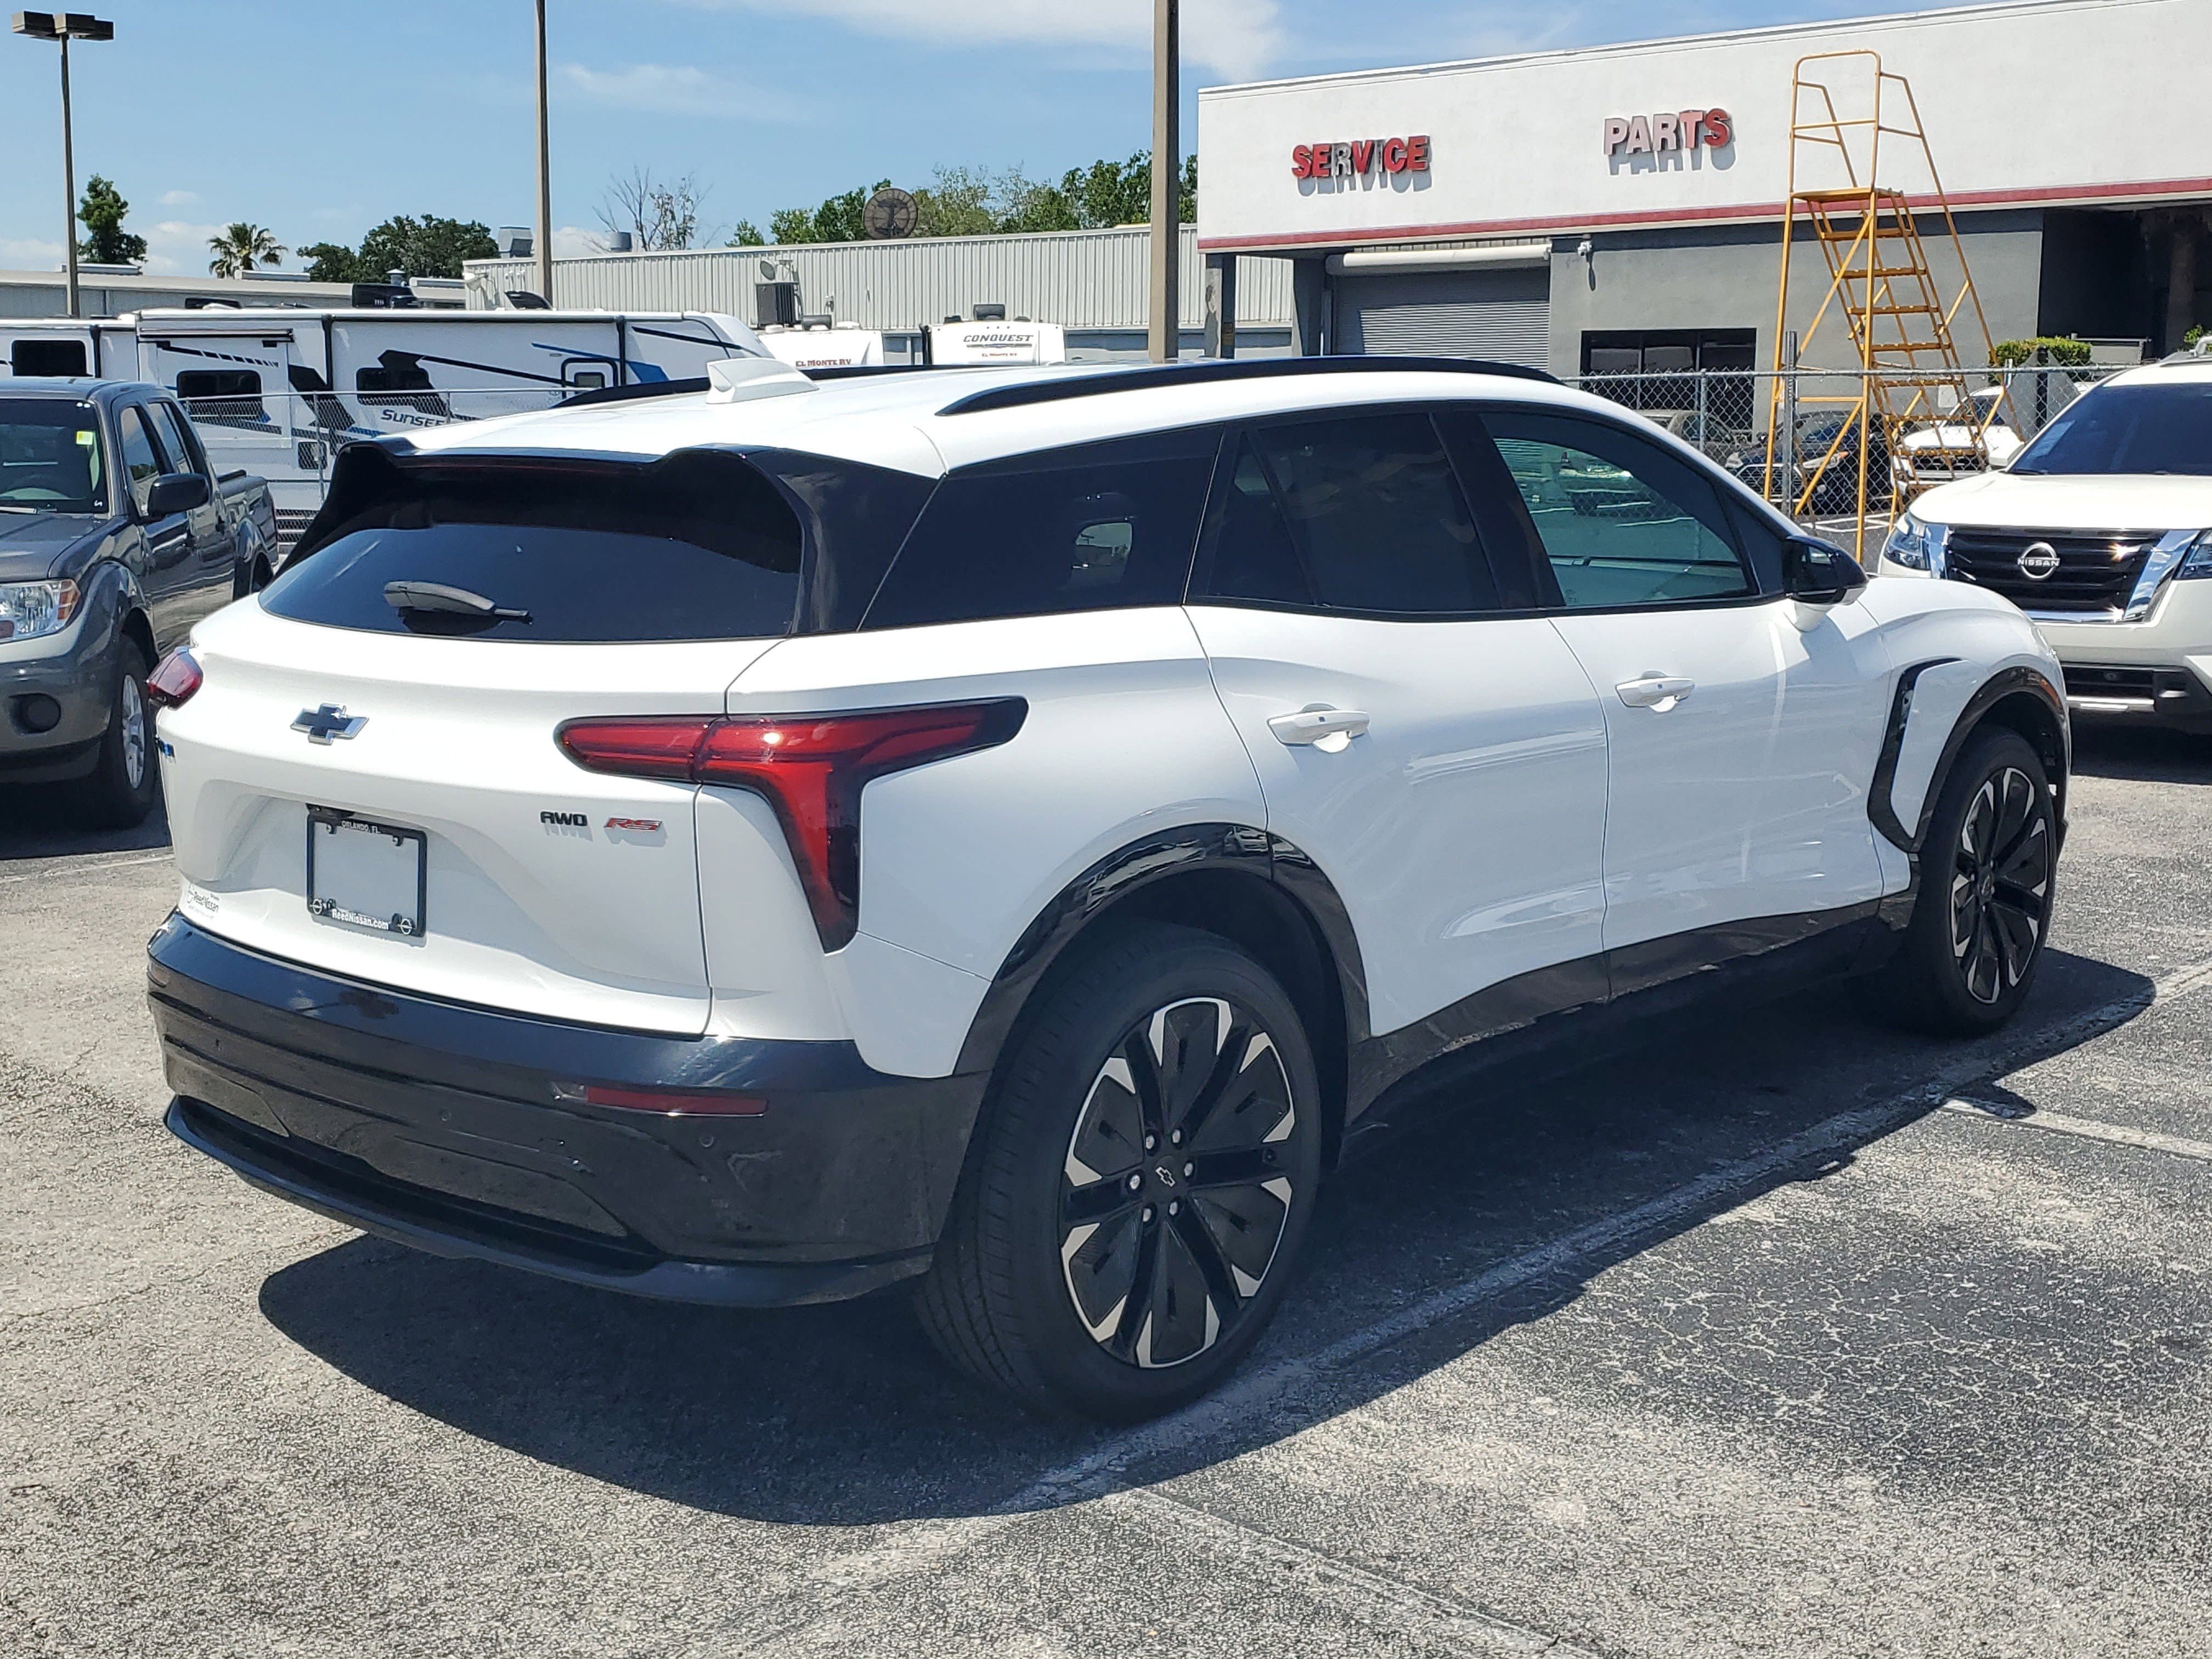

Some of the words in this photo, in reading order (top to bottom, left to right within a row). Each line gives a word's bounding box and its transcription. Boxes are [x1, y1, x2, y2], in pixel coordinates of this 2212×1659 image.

[1604, 108, 1733, 155] PARTS
[1291, 135, 1431, 179] SERVICE
[963, 334, 1034, 342] CONQUEST
[2017, 557, 2060, 566] NISSAN
[540, 811, 588, 827] AWD
[603, 817, 663, 831] RS
[331, 909, 389, 930] ReedNissan.com
